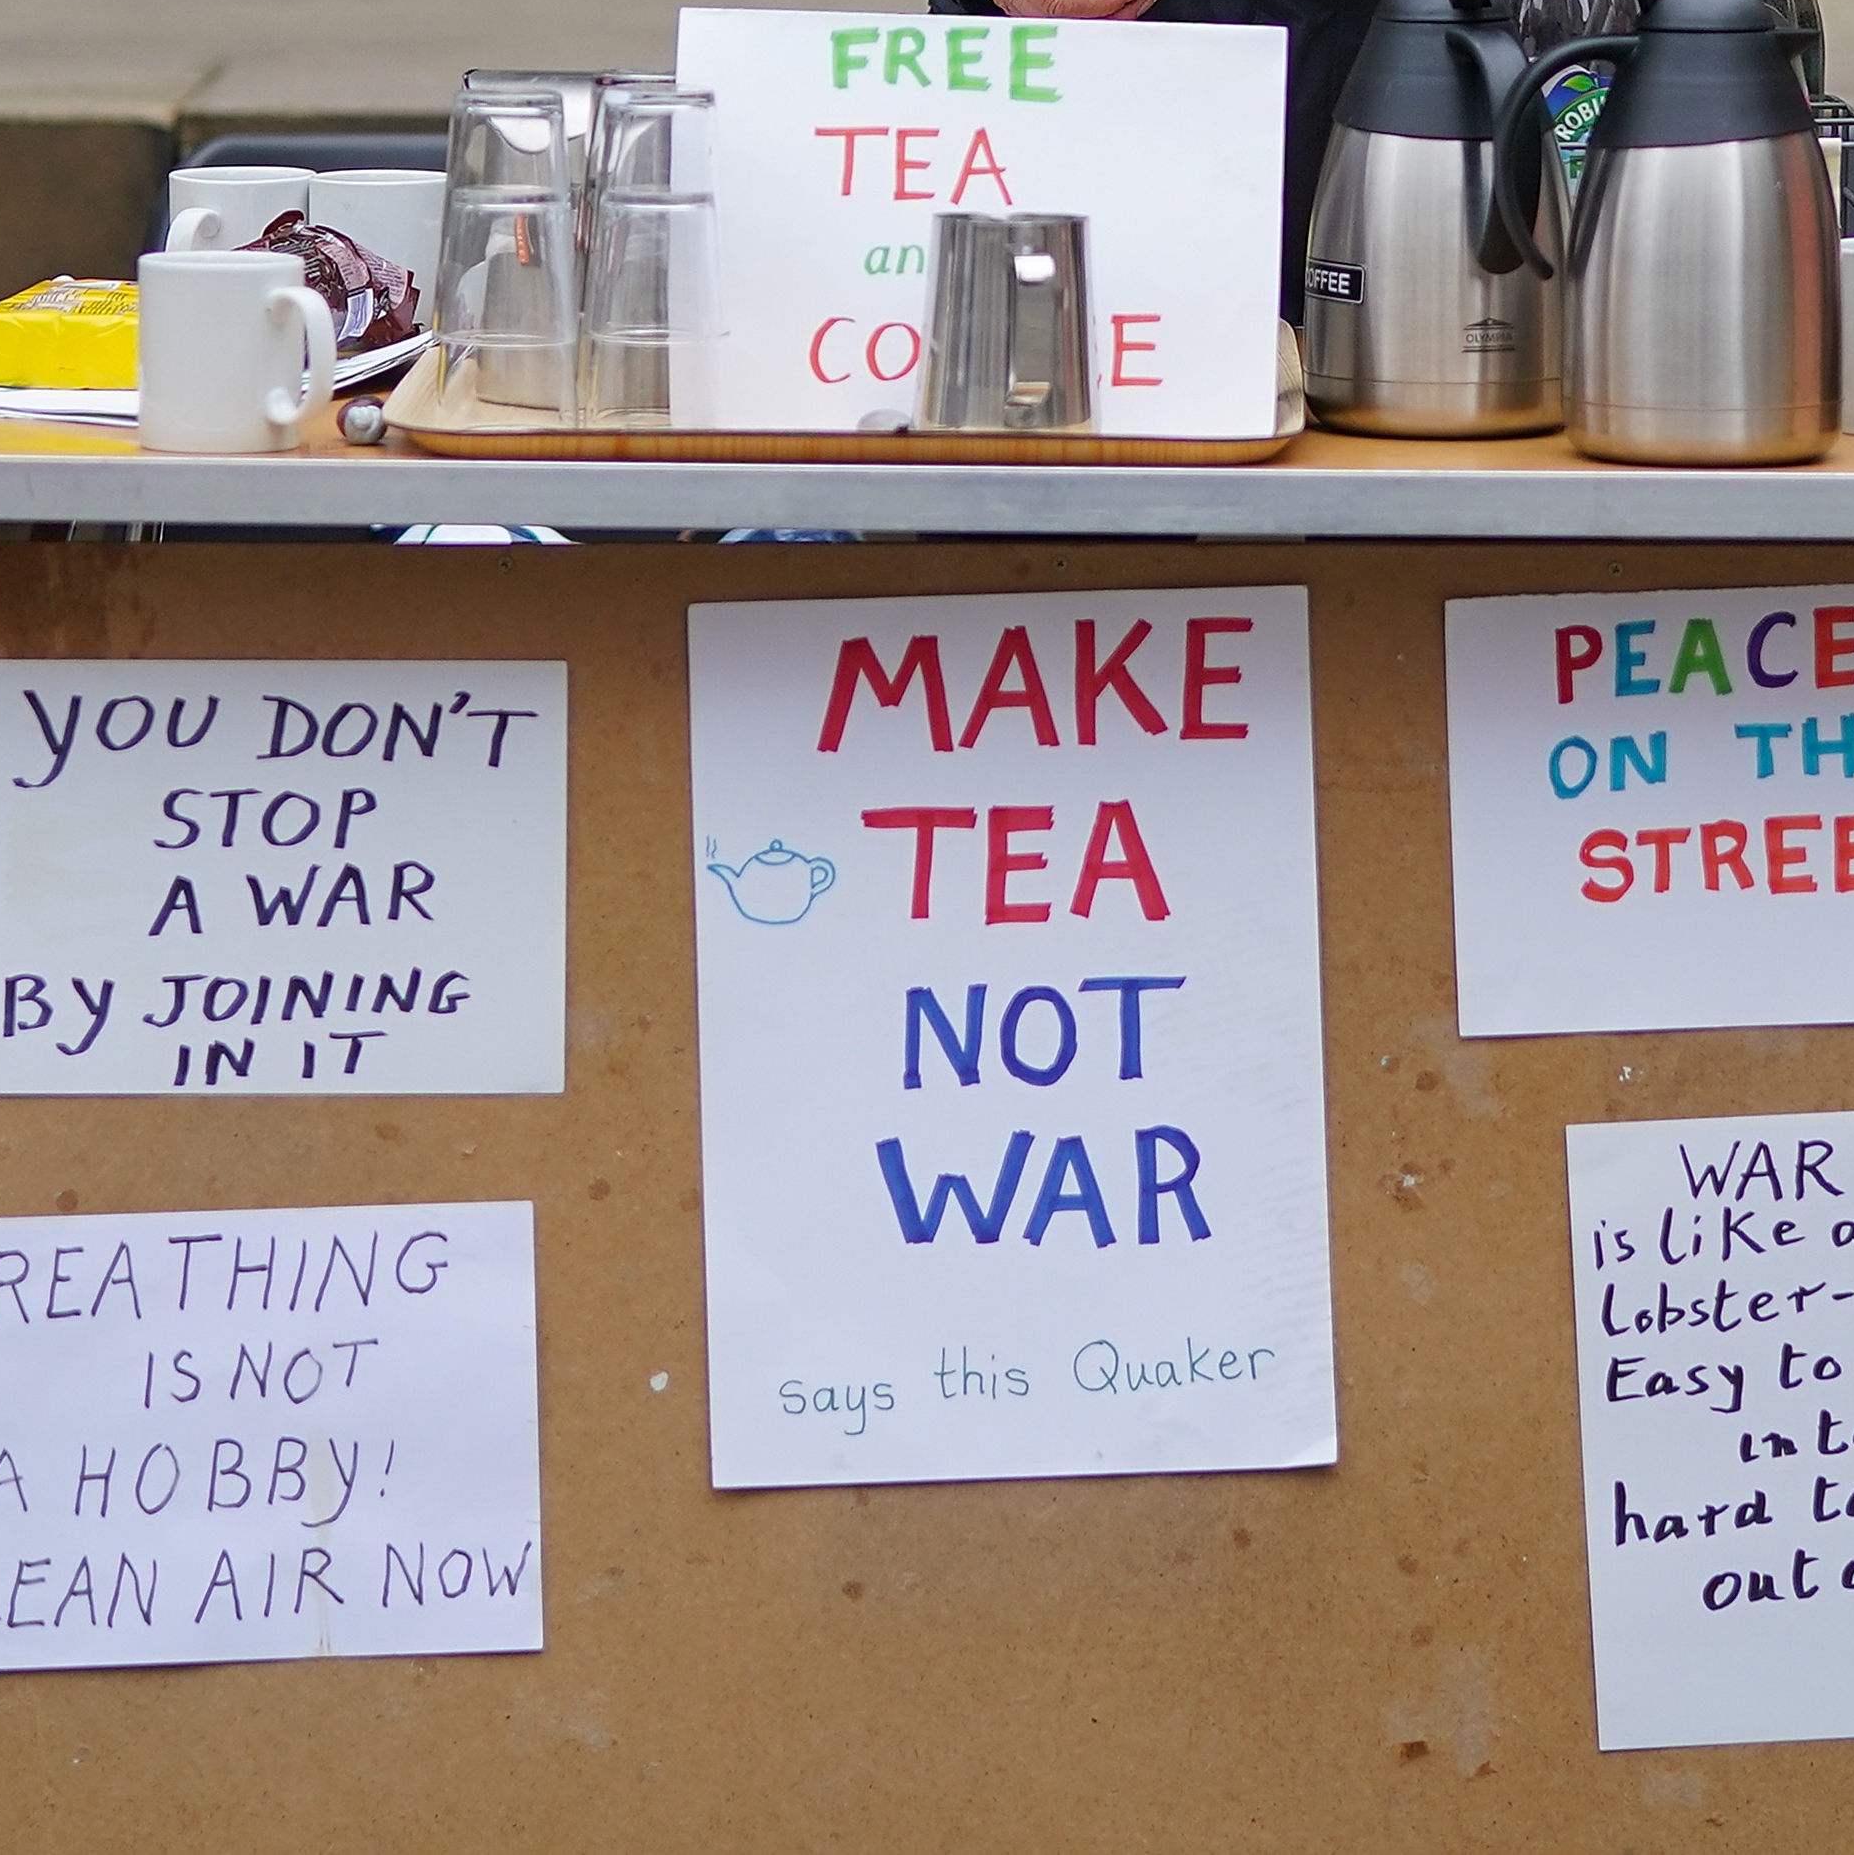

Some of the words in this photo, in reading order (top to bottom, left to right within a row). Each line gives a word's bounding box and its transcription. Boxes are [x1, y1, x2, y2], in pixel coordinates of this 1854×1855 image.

[830, 25, 1062, 103] FREE
[815, 127, 1012, 206] TEA
[864, 244, 925, 275] an
[1305, 267, 1351, 295] OFFEE
[808, 313, 1163, 386] COE
[816, 617, 1254, 753] MAKE
[256, 691, 538, 767] DON'T
[1548, 730, 1667, 799] ON
[154, 787, 377, 849] STOP
[861, 799, 1171, 926] TEA
[148, 876, 203, 936] A
[246, 861, 435, 927] WAR
[142, 967, 470, 1028] JOINING
[903, 975, 1186, 1090] NOT
[173, 1038, 255, 1086] IN
[302, 1030, 387, 1079] IT
[876, 1124, 1212, 1249] WAR
[1679, 1139, 1845, 1202] WAR
[1593, 1220, 1635, 1271] is
[143, 1349, 201, 1408] IS
[230, 1338, 379, 1404] NOT
[777, 1379, 895, 1436] says
[934, 1346, 1030, 1399] this
[1072, 1337, 1275, 1394] Quaker
[1606, 1356, 1744, 1413] Easy
[1780, 1343, 1841, 1389] to
[74, 1437, 395, 1528] HOBBY!
[1614, 1481, 1772, 1546] hard
[195, 1546, 344, 1624] AIR
[382, 1541, 532, 1608] NOW
[1703, 1548, 1819, 1611] out
